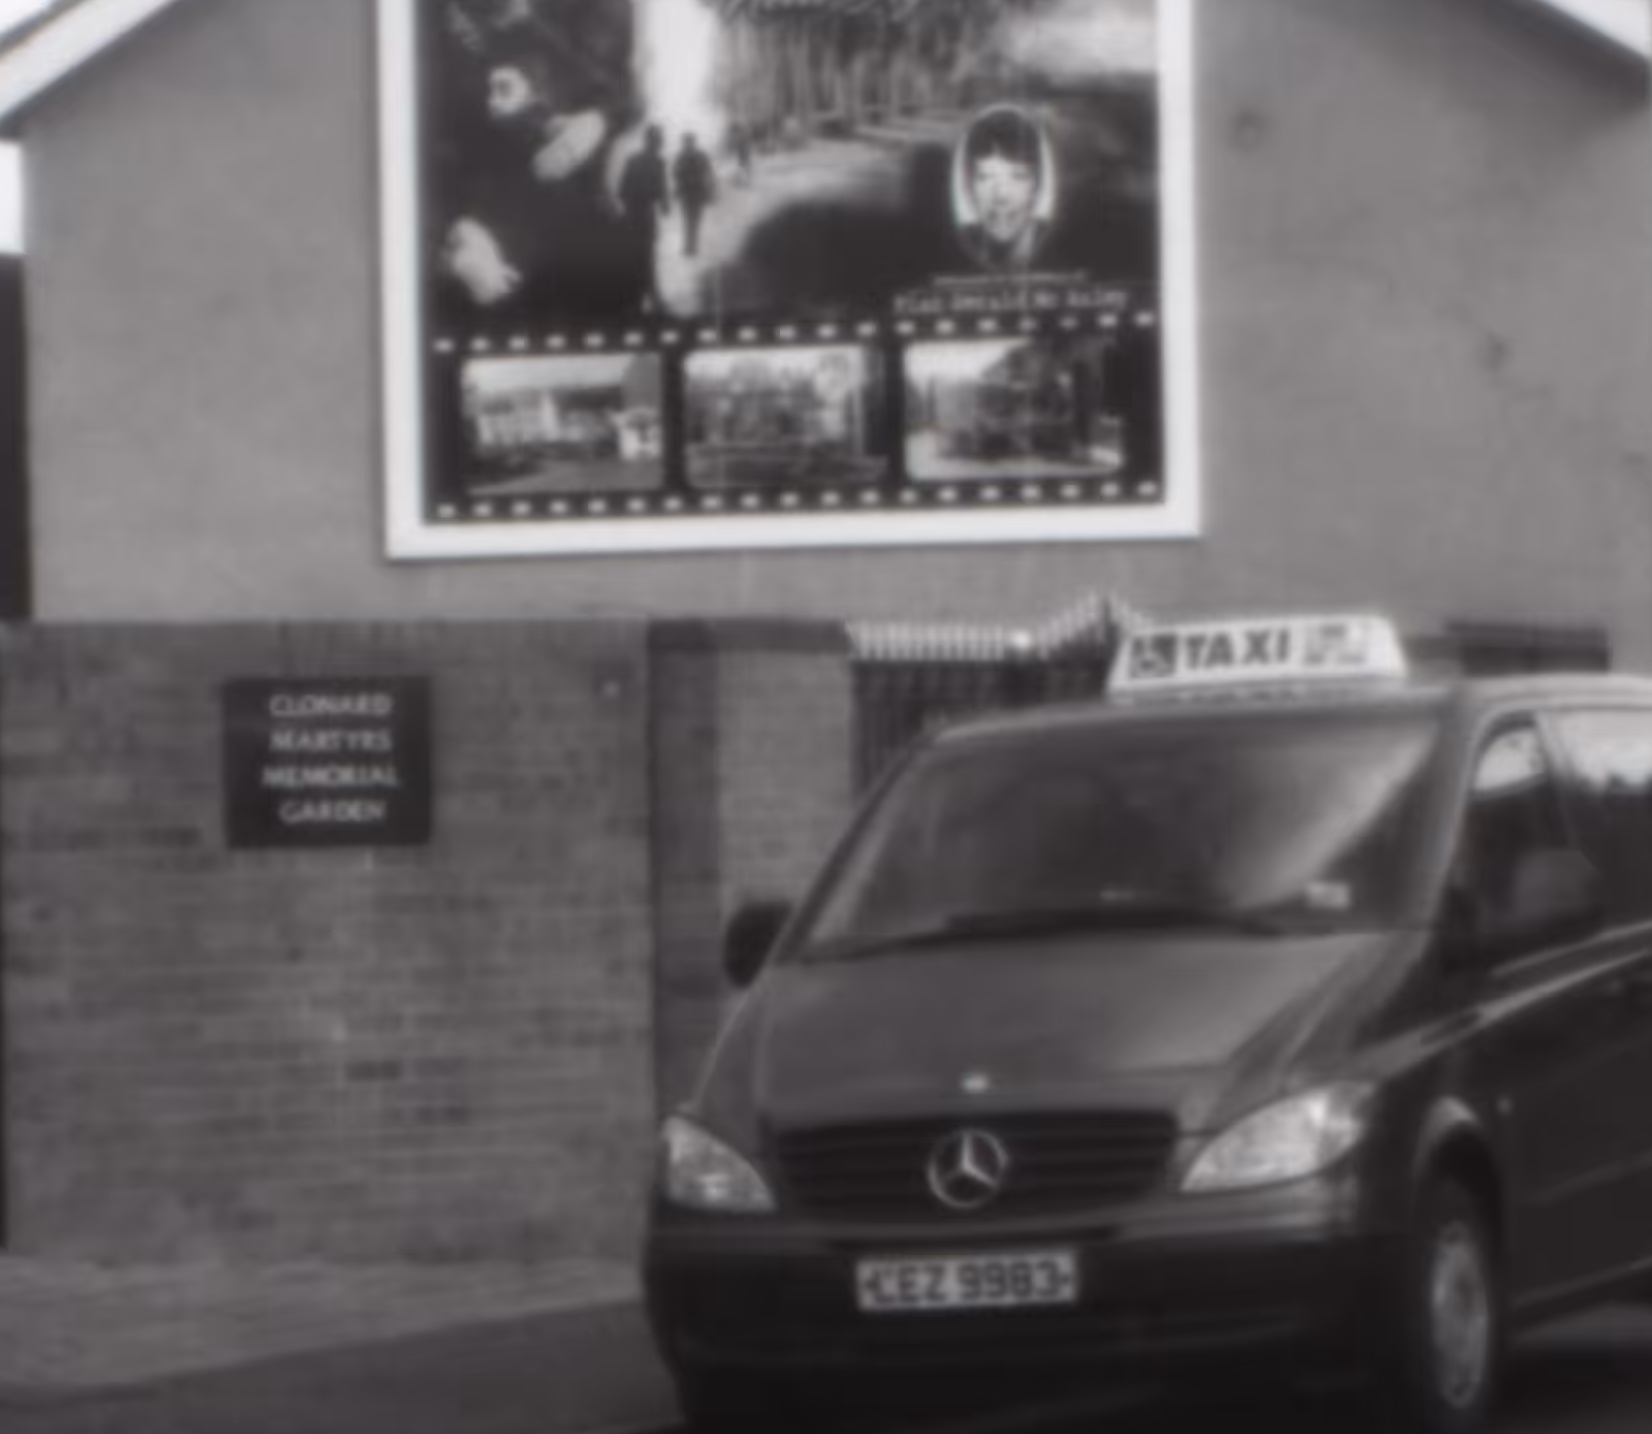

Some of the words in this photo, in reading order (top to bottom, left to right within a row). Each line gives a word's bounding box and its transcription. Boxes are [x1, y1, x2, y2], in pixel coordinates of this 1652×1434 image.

[1185, 627, 1290, 670] TAXI
[268, 693, 394, 718] CLONARD
[268, 728, 393, 752] MARTYRS
[262, 764, 399, 788] MEMORIAL
[278, 798, 389, 825] GARDEN
